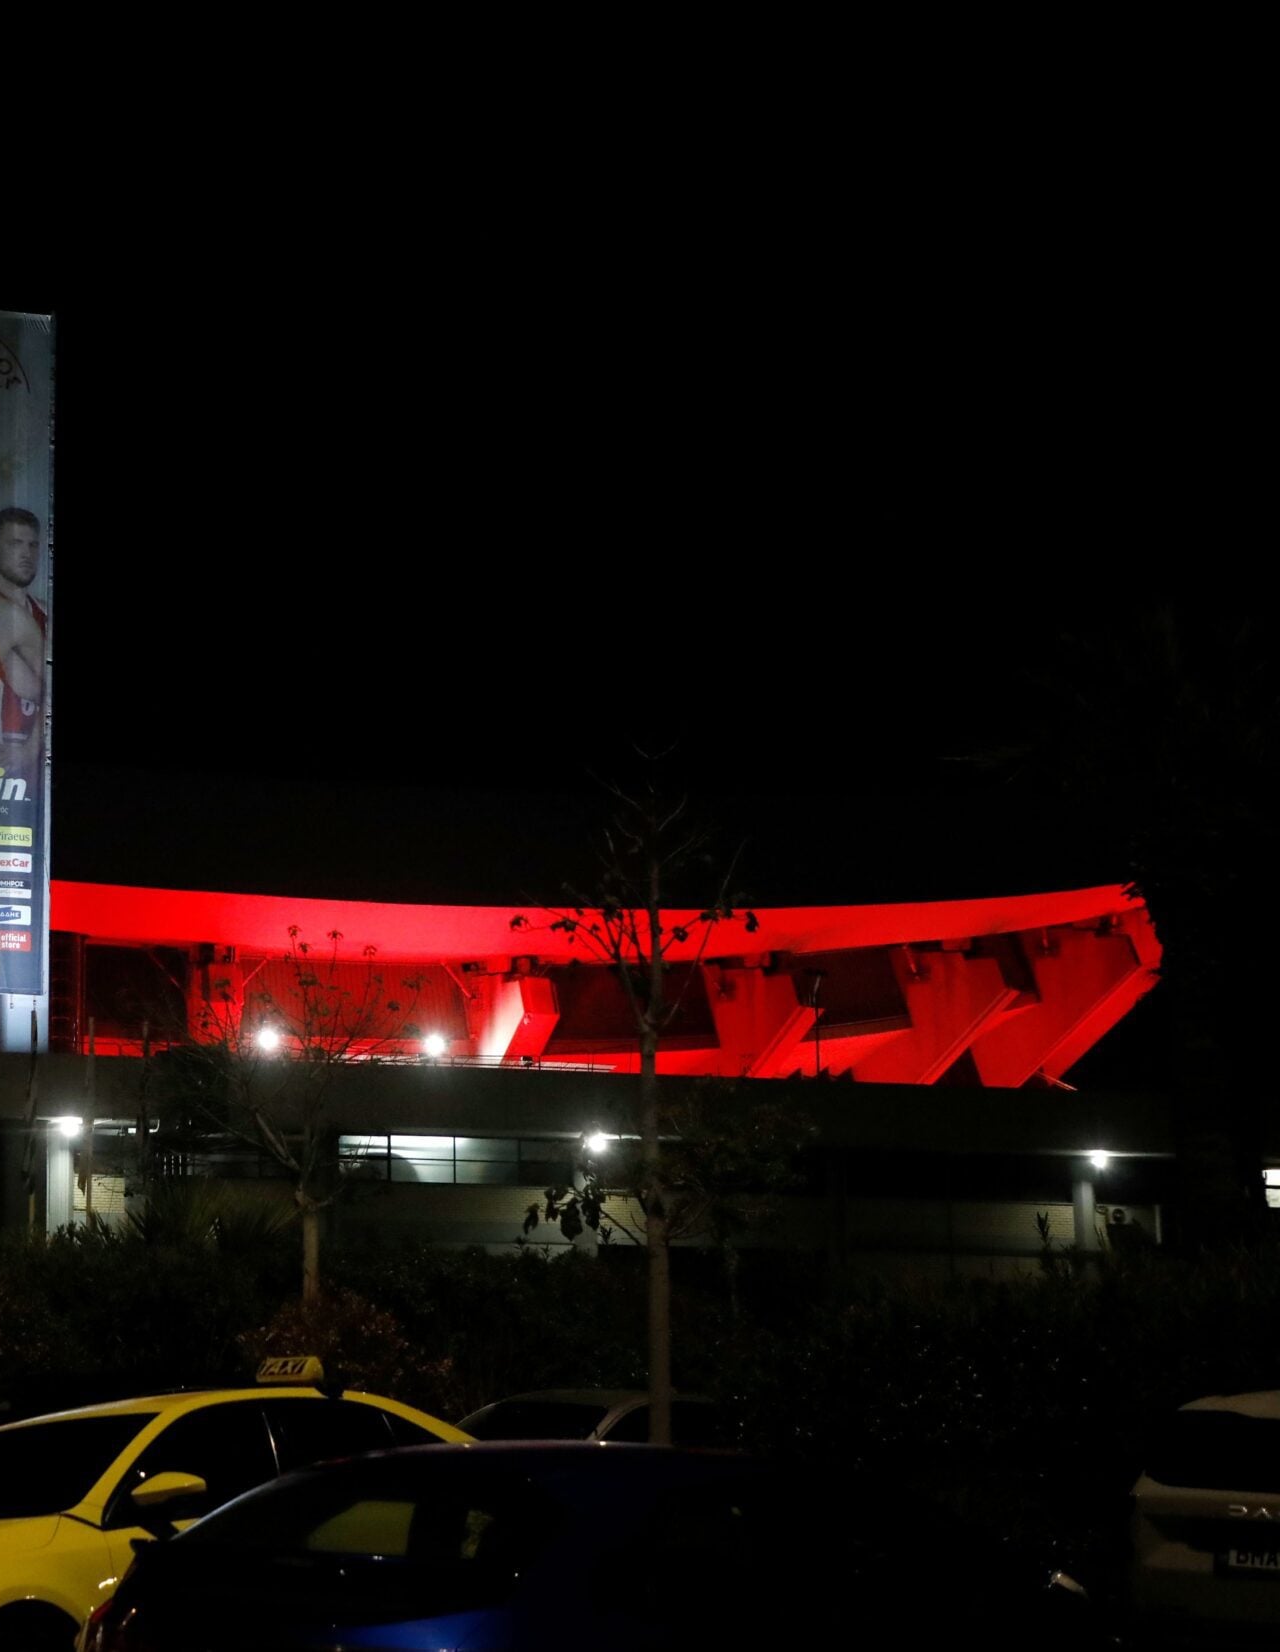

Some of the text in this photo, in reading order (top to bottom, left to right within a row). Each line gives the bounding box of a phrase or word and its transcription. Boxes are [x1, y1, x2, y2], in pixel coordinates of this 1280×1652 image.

[0, 934, 27, 943] official
[1, 941, 21, 949] store
[260, 1359, 307, 1376] TAXI
